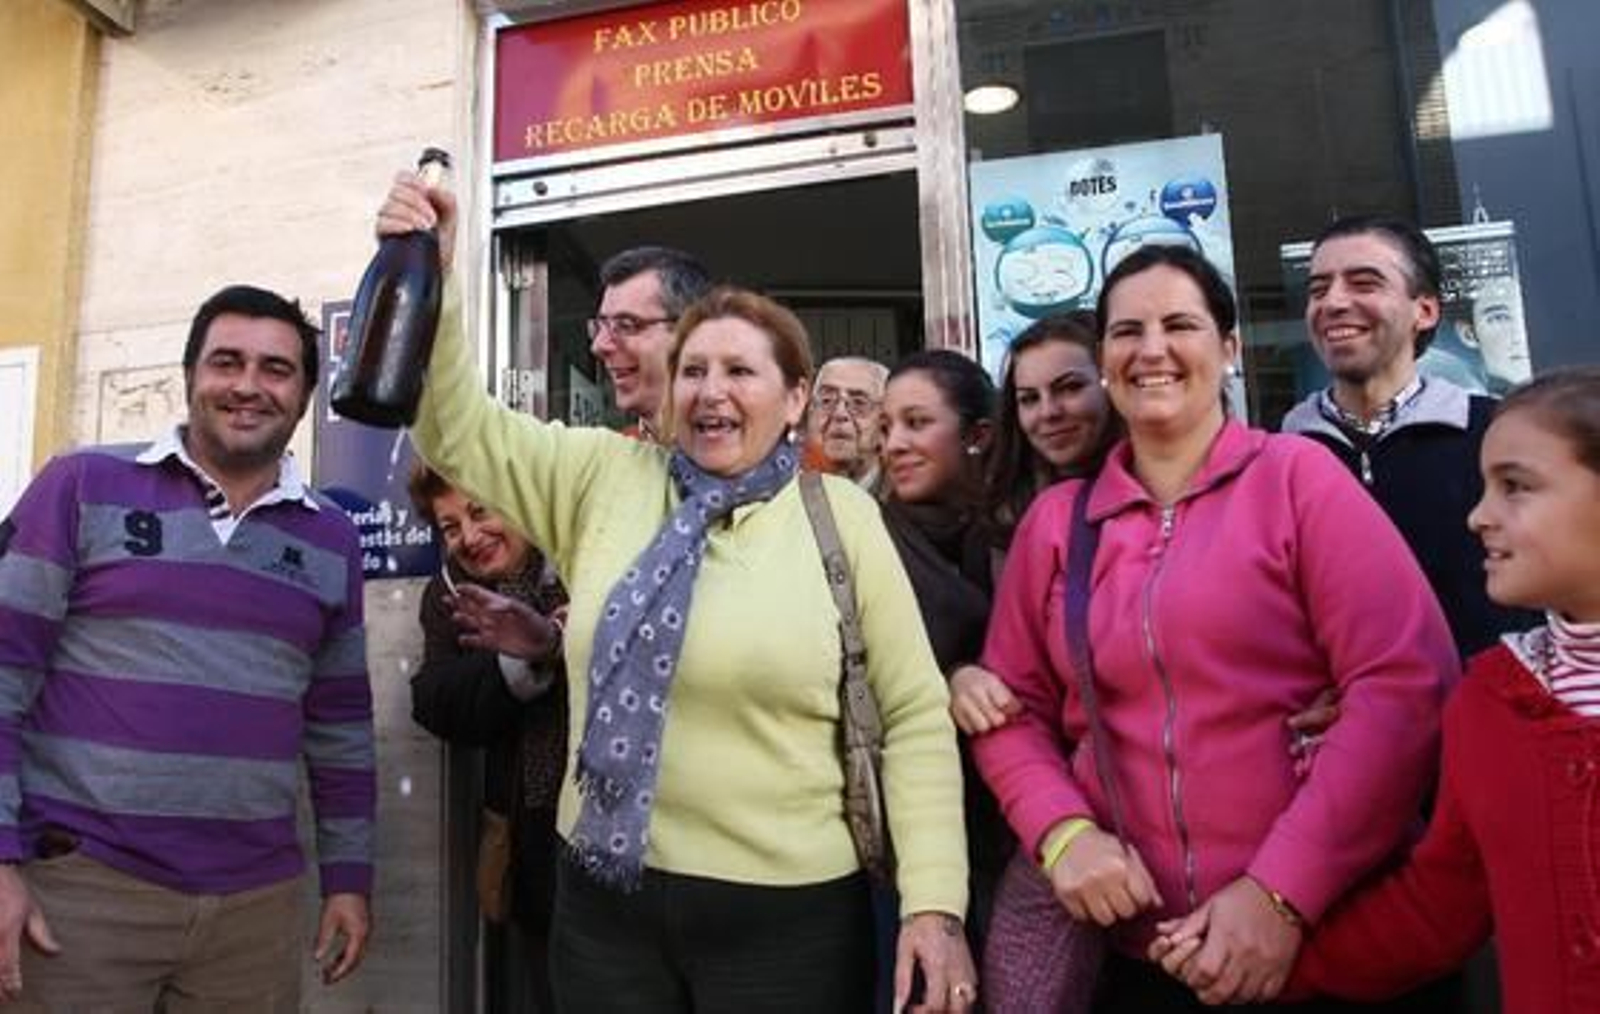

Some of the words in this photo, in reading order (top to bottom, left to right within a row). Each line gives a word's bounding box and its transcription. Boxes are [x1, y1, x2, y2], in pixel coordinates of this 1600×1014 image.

[594, 21, 657, 53] FAX
[669, 0, 800, 40] PUBLICO
[634, 47, 759, 88] PRENSA
[525, 104, 678, 149] RECARGA
[687, 95, 728, 123] DE
[738, 72, 883, 115] MOVILES
[124, 509, 163, 556] 9
[396, 510, 408, 528] y
[405, 526, 431, 546] del
